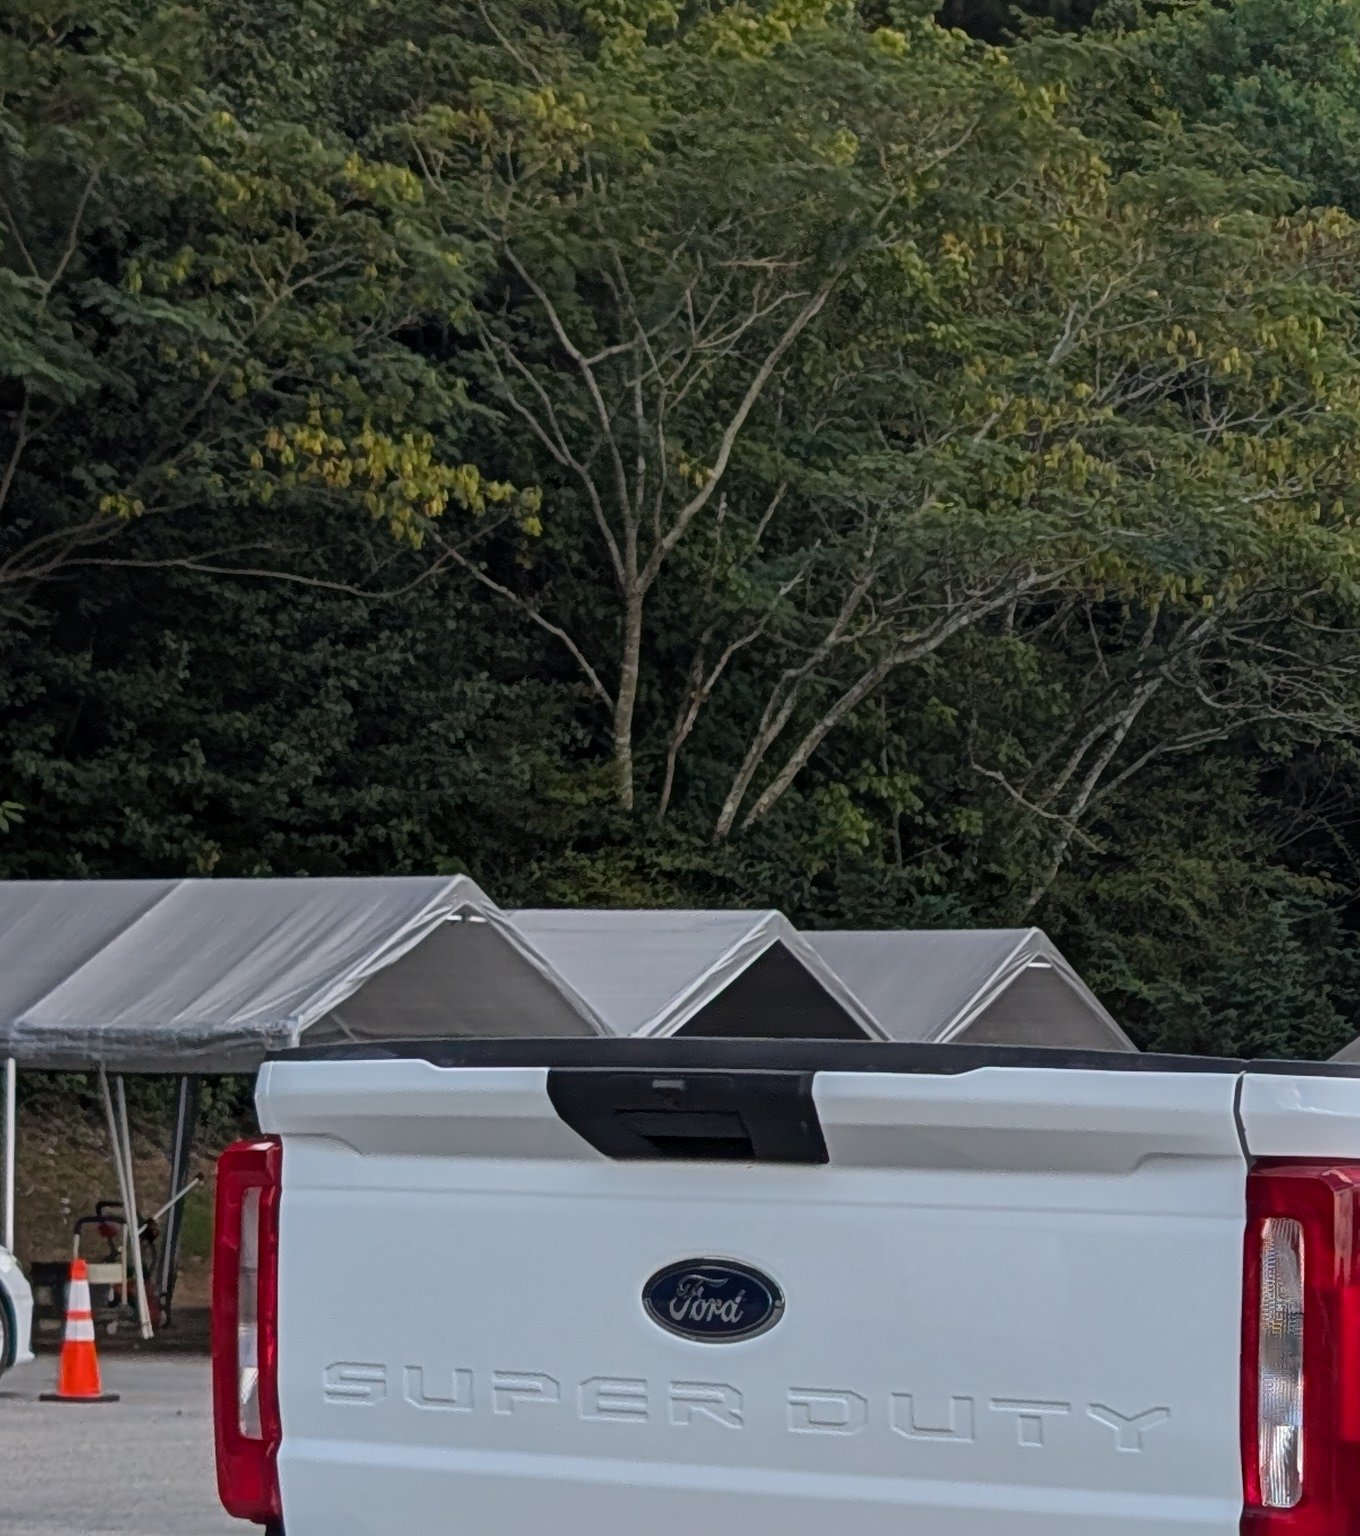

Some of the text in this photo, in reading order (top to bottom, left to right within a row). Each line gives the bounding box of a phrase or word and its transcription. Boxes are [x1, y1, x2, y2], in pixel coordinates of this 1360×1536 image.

[669, 1274, 744, 1323] Ford
[322, 1361, 1171, 1453] SUPER DUTY
